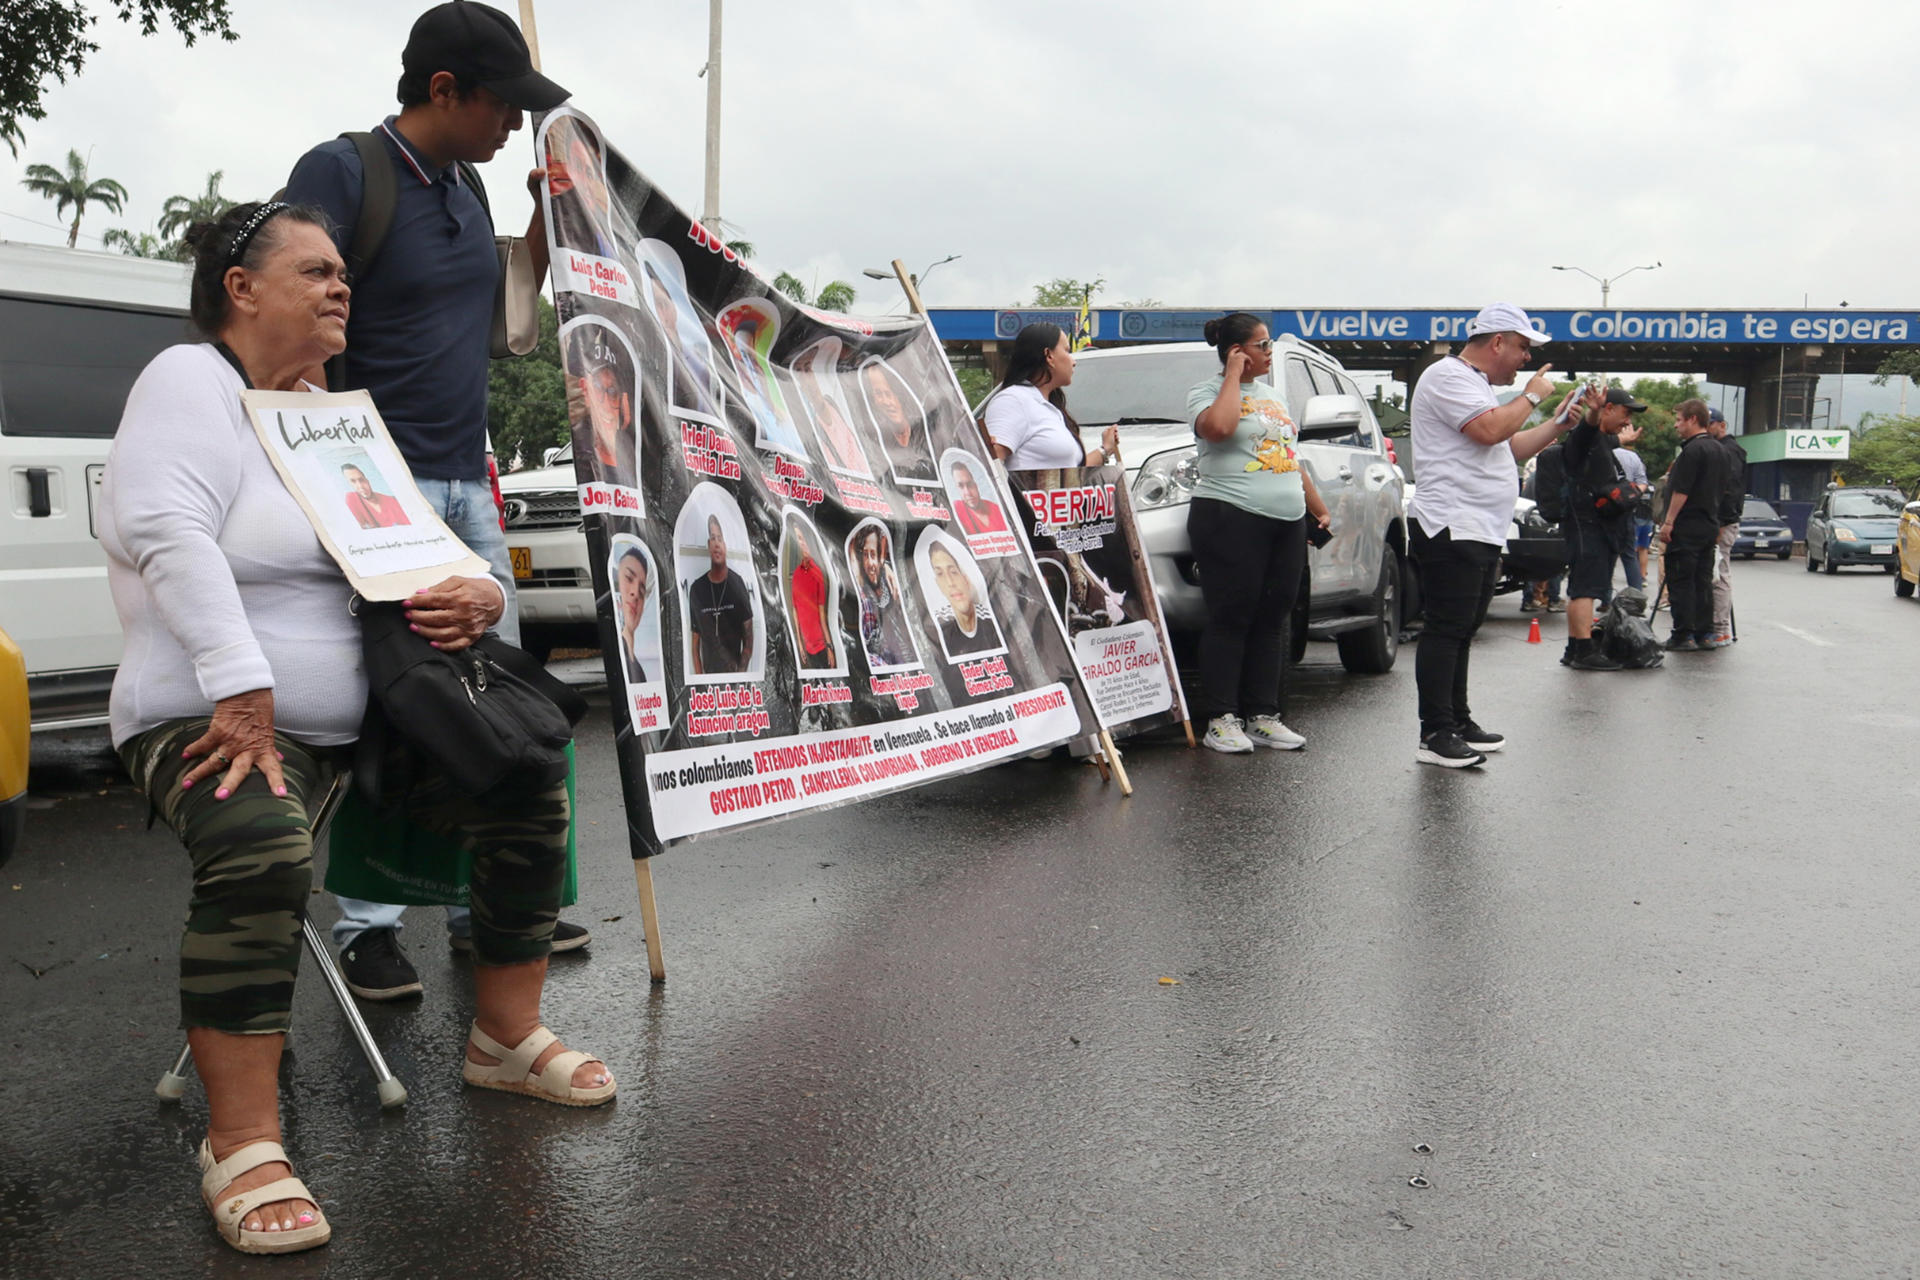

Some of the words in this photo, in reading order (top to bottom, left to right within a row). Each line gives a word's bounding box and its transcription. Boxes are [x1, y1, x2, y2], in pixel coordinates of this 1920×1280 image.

[570, 256, 592, 276] Luis
[594, 262, 627, 286] Carlos
[589, 278, 617, 299] Peña
[1296, 311, 1408, 337] Vuelve
[1569, 311, 1727, 338] Colombia
[1742, 313, 1778, 338] te
[1790, 315, 1909, 343] espera
[277, 411, 375, 451] Libertad
[681, 422, 707, 449] Arlei
[1790, 435, 1821, 449] ICA
[683, 446, 716, 477] Espitia
[718, 454, 741, 479] Lara
[791, 479, 824, 506] Barajas
[1024, 485, 1116, 525] BERTAD
[1102, 640, 1136, 659] JAVIER
[991, 674, 1014, 691] Soto
[1082, 659, 1122, 681] GIRALDO
[689, 686, 715, 711] José
[715, 684, 737, 709] Luis
[739, 685, 751, 707] de
[751, 684, 763, 706] la
[870, 675, 896, 695] Manuel
[651, 768, 677, 792] nos
[679, 754, 754, 787] colombianos
[753, 744, 808, 775] DETENIDOS
[807, 735, 874, 764] INJUSTAMENTE
[873, 738, 887, 753] en
[884, 726, 933, 751] Venezuela
[934, 721, 949, 739] Se
[946, 720, 971, 736] hace
[968, 708, 1005, 731] llamado
[1005, 705, 1016, 722] al
[1013, 690, 1066, 719] PRESIDENTE
[709, 783, 763, 816] GUSTAVO
[762, 777, 797, 804] PETRO
[801, 761, 862, 796] CANCILLERÍA
[858, 753, 919, 783] COLOMBIANA
[920, 742, 964, 768] GOBIERNO
[961, 739, 976, 758] DE
[973, 727, 1019, 754] VENEZUELA
